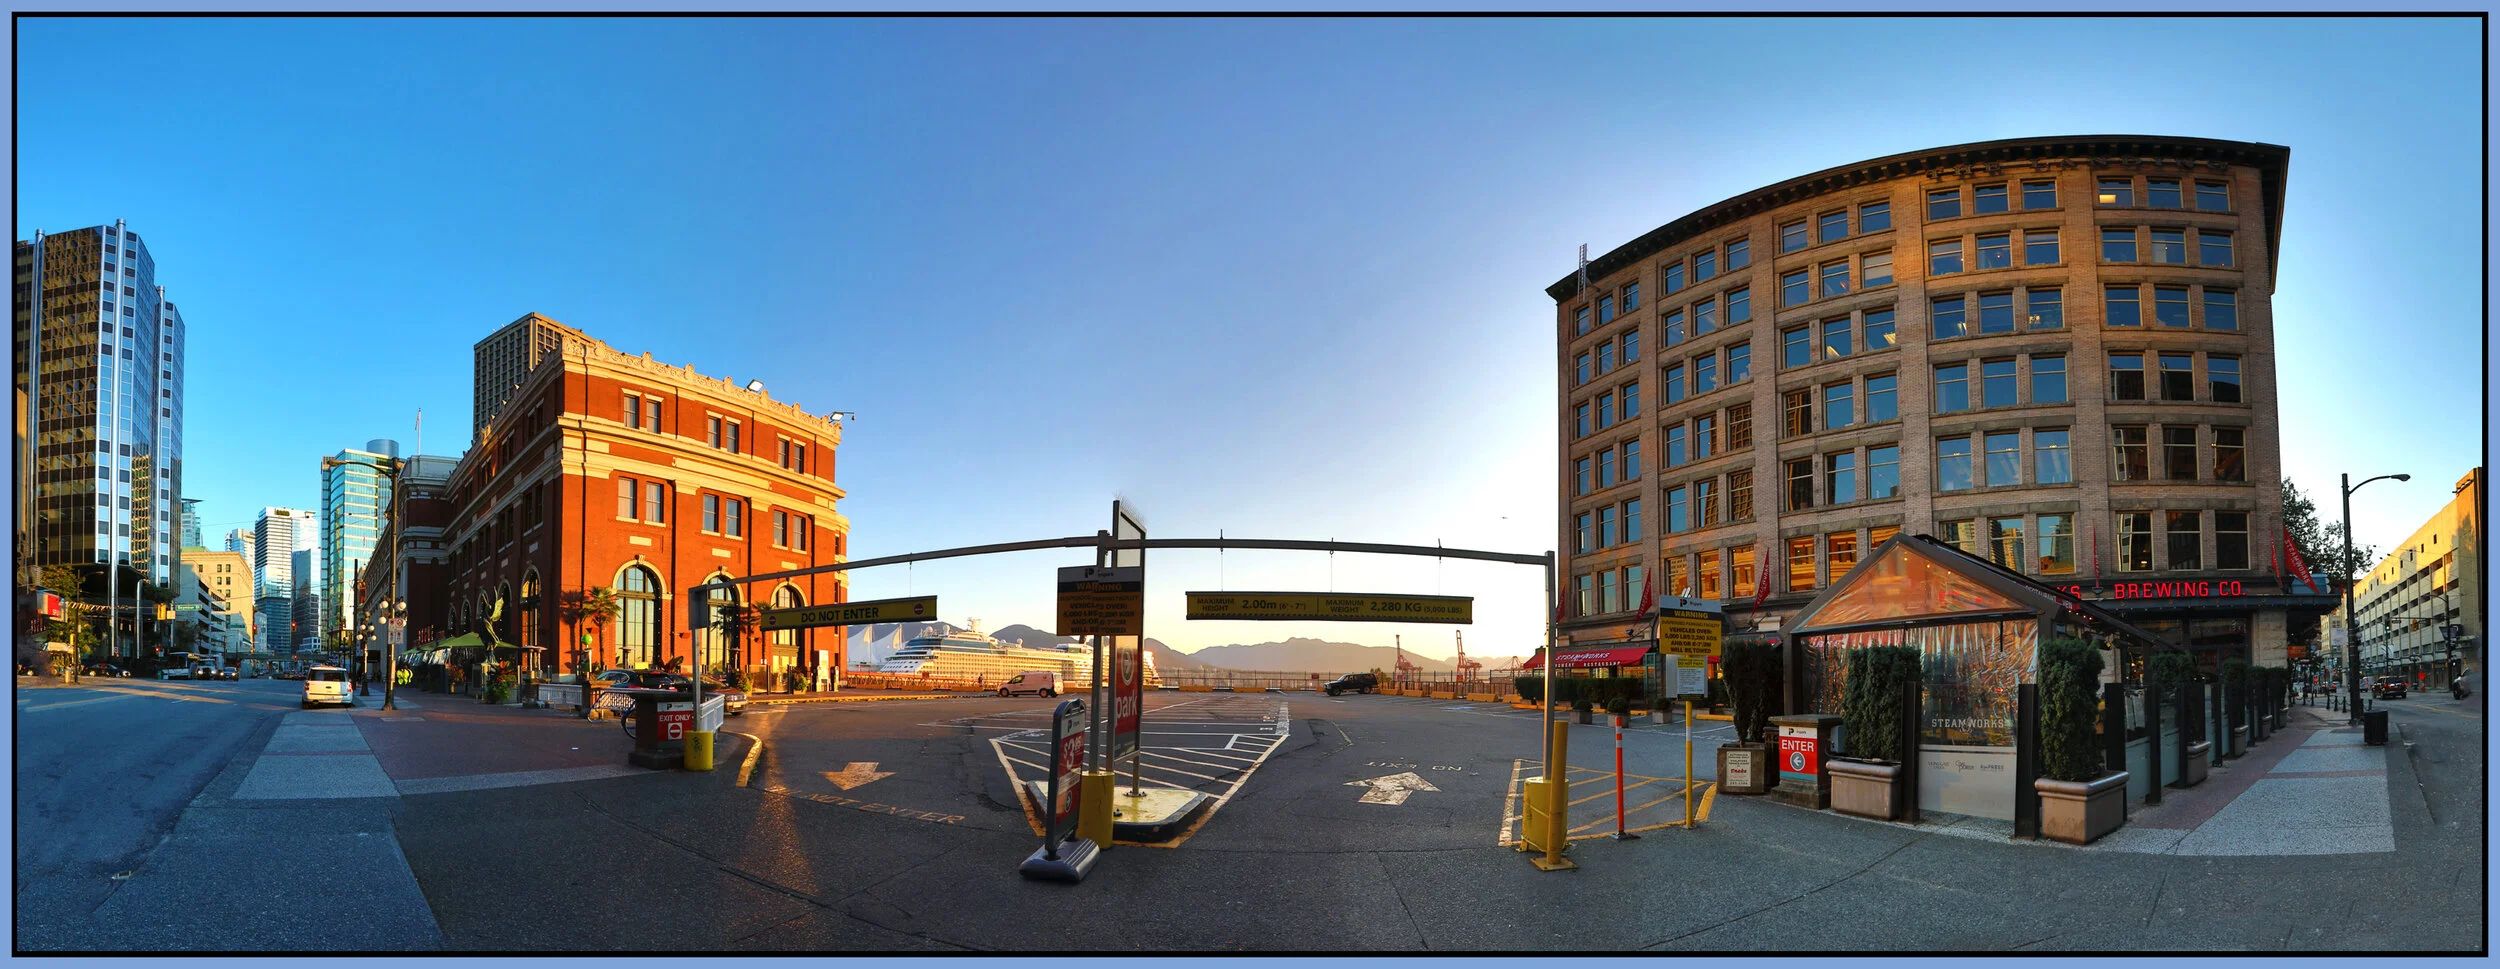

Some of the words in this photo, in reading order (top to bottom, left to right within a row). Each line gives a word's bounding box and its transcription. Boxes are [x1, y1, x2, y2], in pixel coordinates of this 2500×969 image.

[2284, 540, 2311, 584] STEAMWORKS
[2114, 581, 2209, 599] BREWING
[2218, 580, 2247, 597] CO.
[1242, 600, 1277, 609] 2.00m
[1370, 601, 1402, 612] 2,280
[1405, 602, 1421, 612] KG
[801, 612, 816, 623] DO
[818, 610, 841, 622] NOT
[843, 607, 879, 620] ENTER
[1673, 610, 1709, 619] WARNING
[1555, 652, 1610, 661] STEAMWORKS
[1115, 689, 1138, 719] park
[659, 714, 673, 722] EXIT
[1931, 718, 2004, 728] STEAMWORKS
[1781, 739, 1815, 752] ENTER
[858, 802, 966, 825] ENTER
